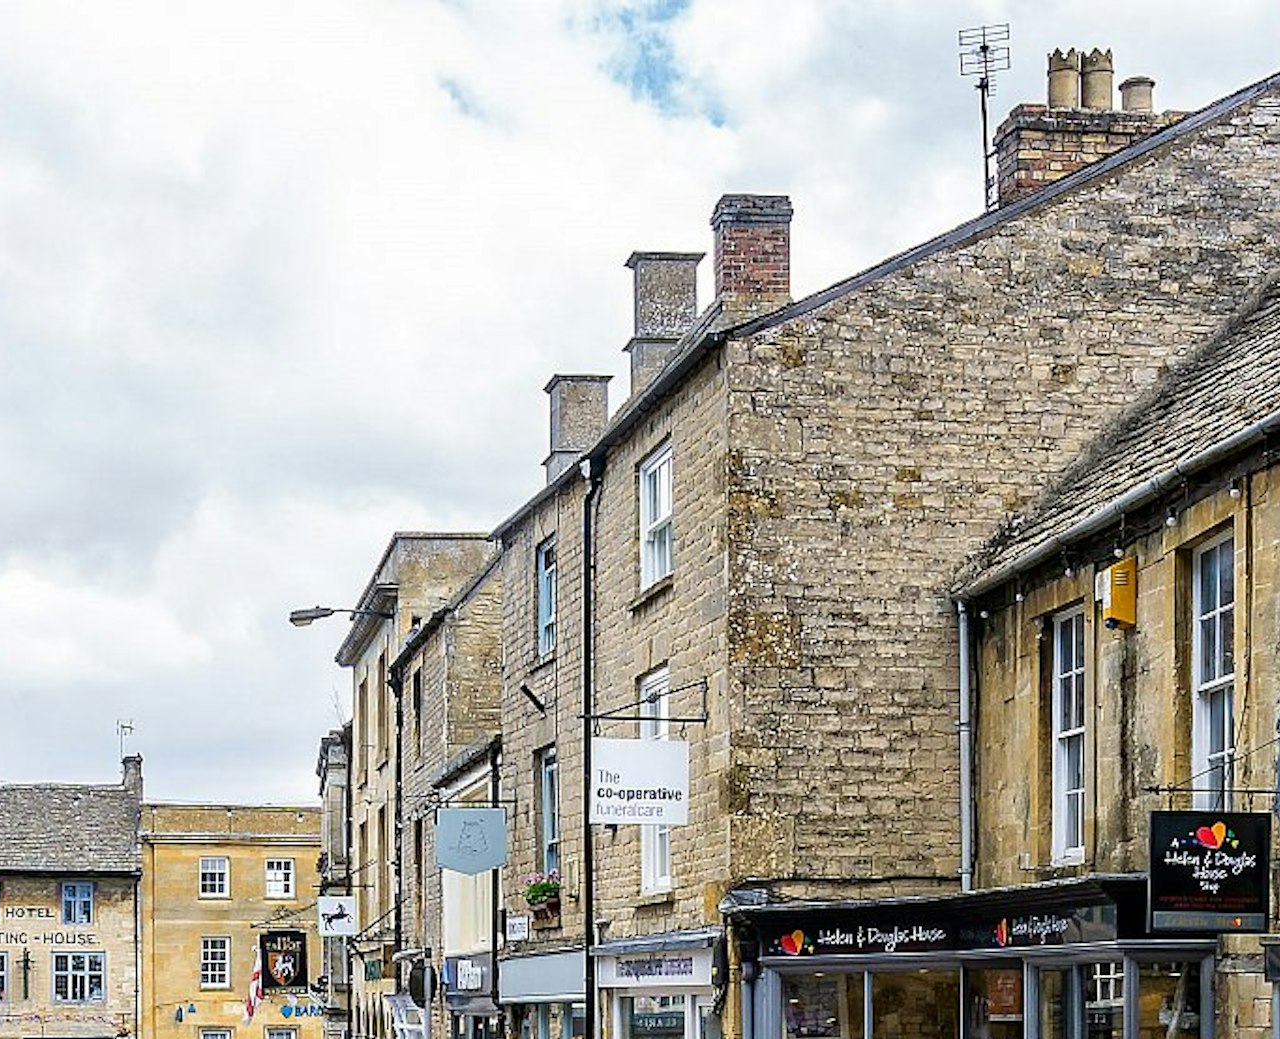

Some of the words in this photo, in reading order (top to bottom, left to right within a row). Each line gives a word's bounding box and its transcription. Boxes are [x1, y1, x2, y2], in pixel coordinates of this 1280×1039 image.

[598, 768, 620, 784] The
[597, 787, 683, 802] co-operative
[596, 801, 663, 817] funeralcare
[1170, 837, 1180, 849] A
[1164, 850, 1200, 867] Helen
[1203, 850, 1213, 868] &
[1214, 851, 1258, 875] Douglas
[5, 907, 56, 918] HOTEL
[817, 927, 853, 945] Helen
[857, 926, 867, 949] &
[867, 926, 909, 952] Douglas
[910, 926, 947, 943] House
